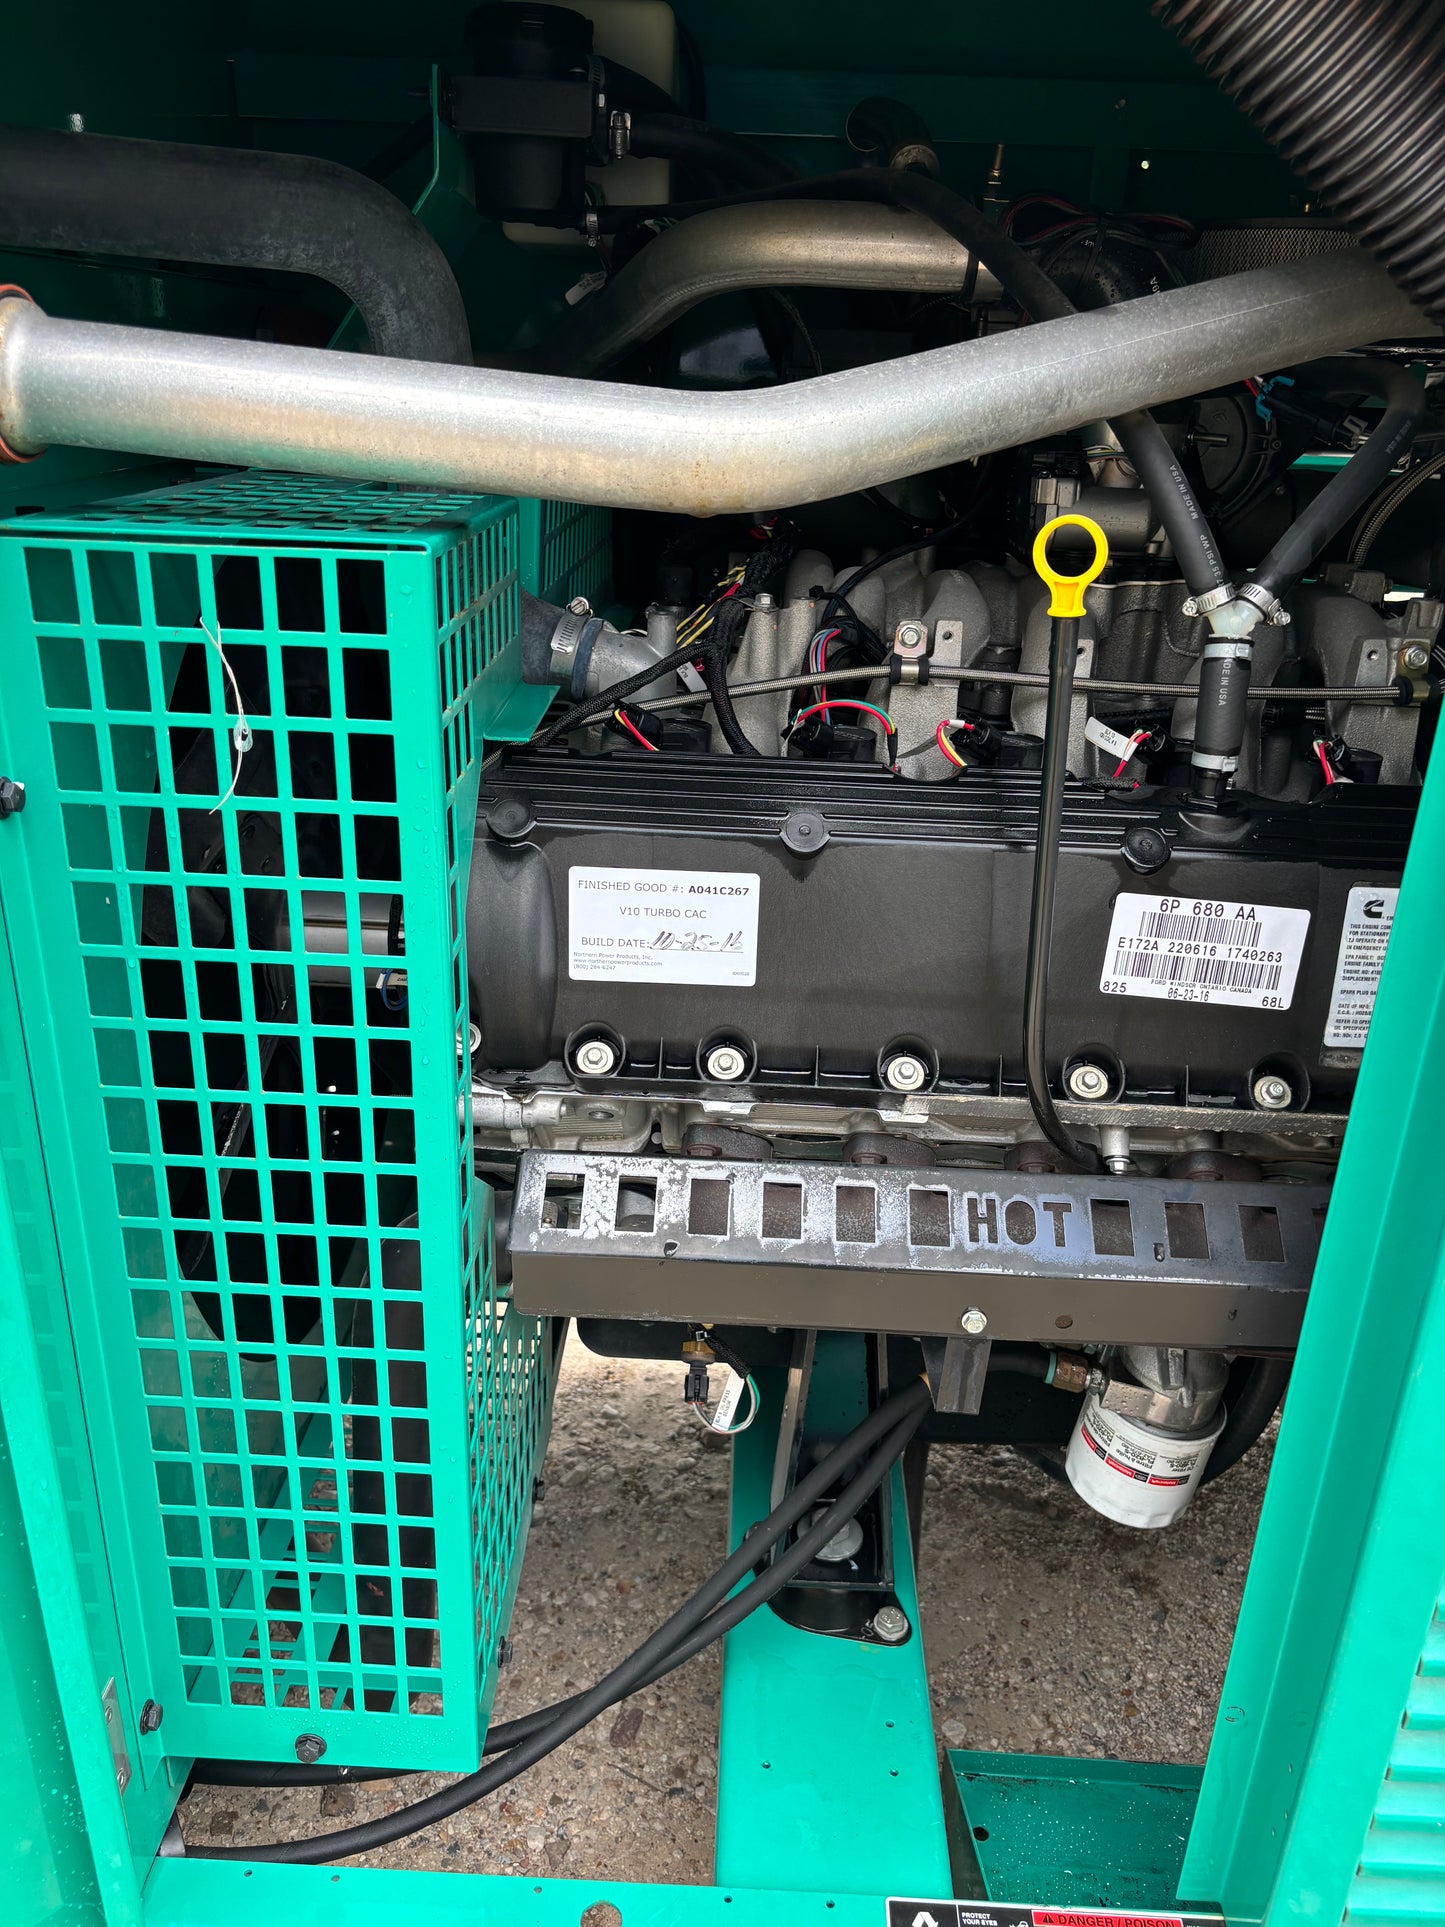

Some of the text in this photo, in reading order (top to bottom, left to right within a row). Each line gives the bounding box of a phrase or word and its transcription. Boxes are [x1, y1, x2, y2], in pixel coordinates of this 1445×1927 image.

[1169, 464, 1182, 482] USA
[1178, 483, 1187, 493] IN
[1182, 494, 1199, 520] MADE
[1200, 534, 1210, 550] WP
[1206, 550, 1217, 565] PSI
[1211, 566, 1221, 577] 35
[1218, 658, 1233, 706] ADE IN USA
[578, 880, 750, 896] FINISHED GOOD #: A041C267
[619, 907, 707, 919] V10 TURBO CAC
[1160, 899, 1256, 921] 6P 680 AA
[581, 937, 650, 949] BUILD DATE:
[1117, 937, 1282, 963] E172A 220616 1740263
[1102, 981, 1127, 993] 825
[1200, 983, 1227, 991] ONTARIO
[1168, 988, 1210, 1002] 06-23-16
[1262, 996, 1284, 1009] 68L
[967, 1197, 1072, 1248] HOT
[962, 1918, 998, 1927] YOUR EYES
[1058, 1915, 1113, 1927] DANGER
[1125, 1919, 1175, 1927] POISON
